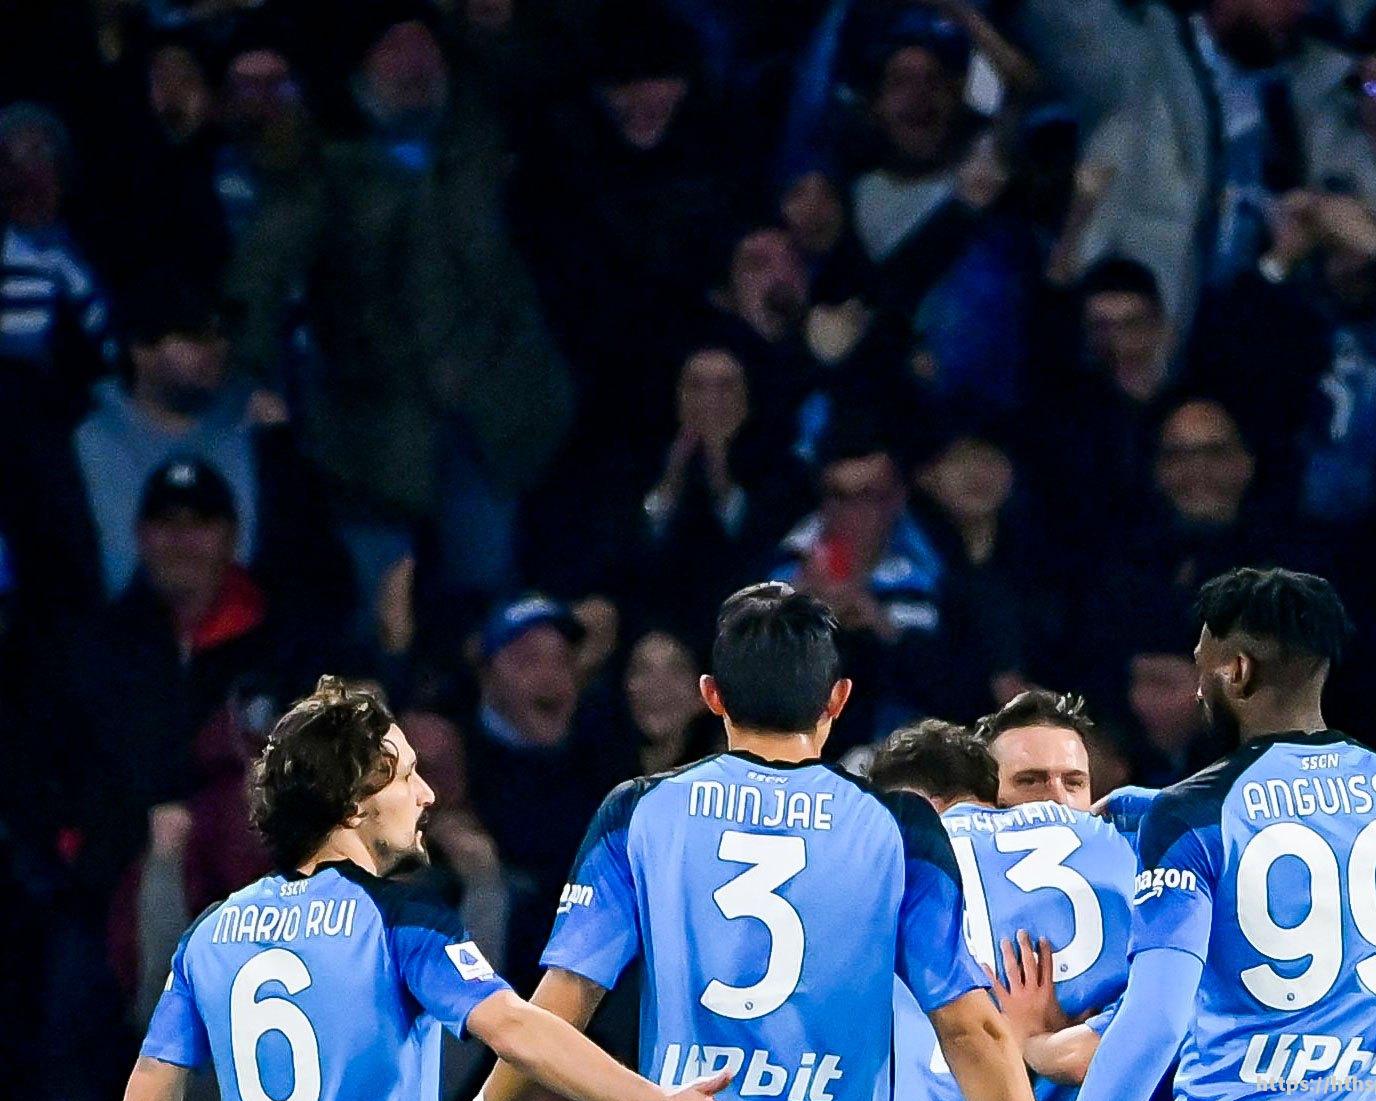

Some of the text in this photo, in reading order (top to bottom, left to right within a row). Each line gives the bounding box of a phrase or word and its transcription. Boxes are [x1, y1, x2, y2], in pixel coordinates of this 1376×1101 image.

[1300, 752, 1340, 771] SSCN
[689, 780, 833, 830] MINJAE
[211, 899, 358, 944] MARIO RUI
[699, 829, 808, 1021] 3
